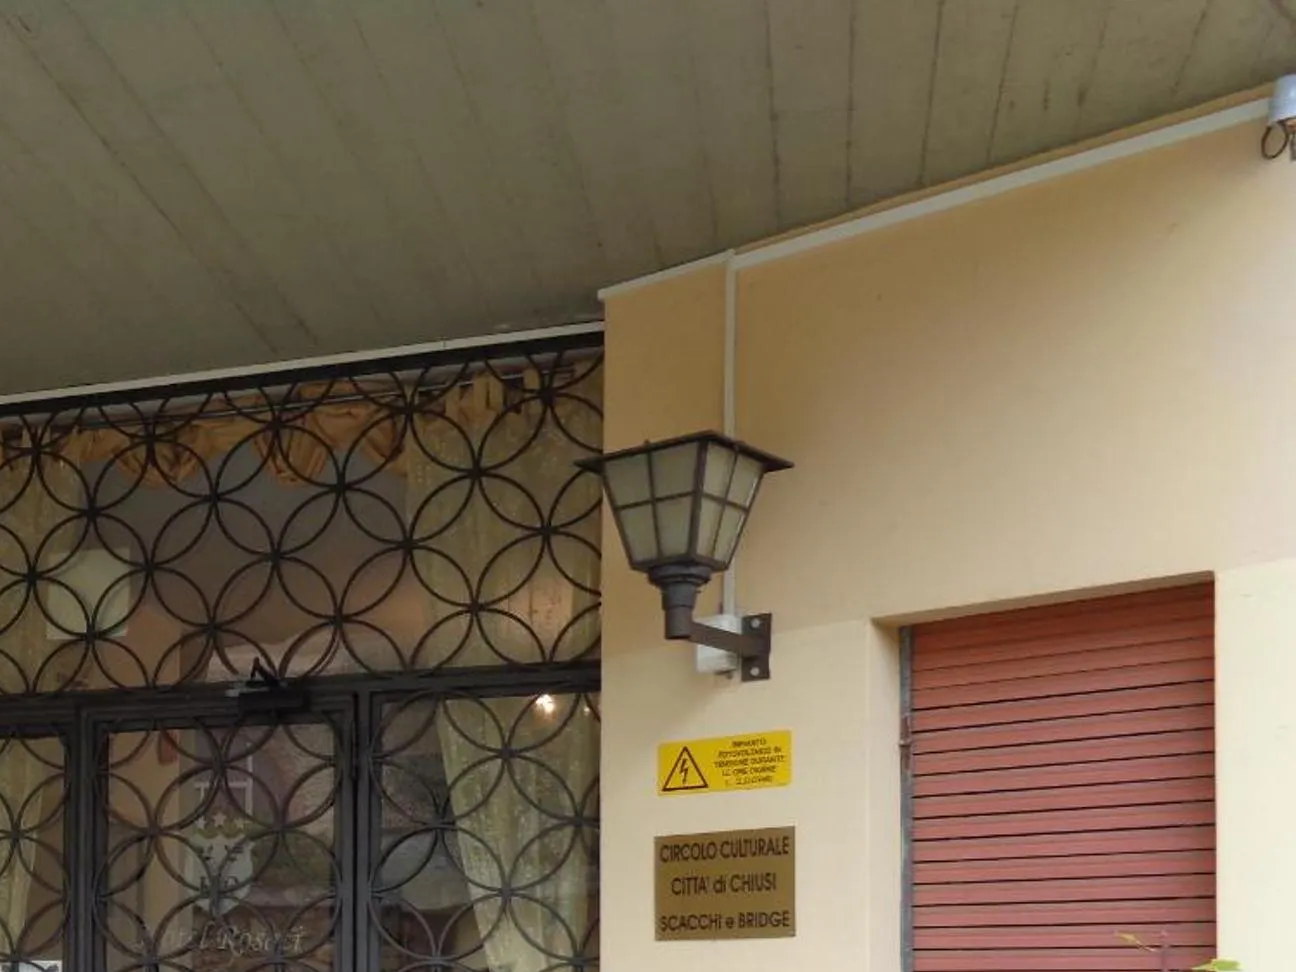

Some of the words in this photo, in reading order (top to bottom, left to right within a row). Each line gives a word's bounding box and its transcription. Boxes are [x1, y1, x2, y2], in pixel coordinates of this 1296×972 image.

[659, 840, 717, 864] CIRCOLO
[719, 835, 790, 859] CULTURALE
[713, 874, 725, 893] di
[729, 871, 777, 893] CHIUSI
[725, 916, 735, 929] e
[738, 909, 791, 928] BRIDGE
